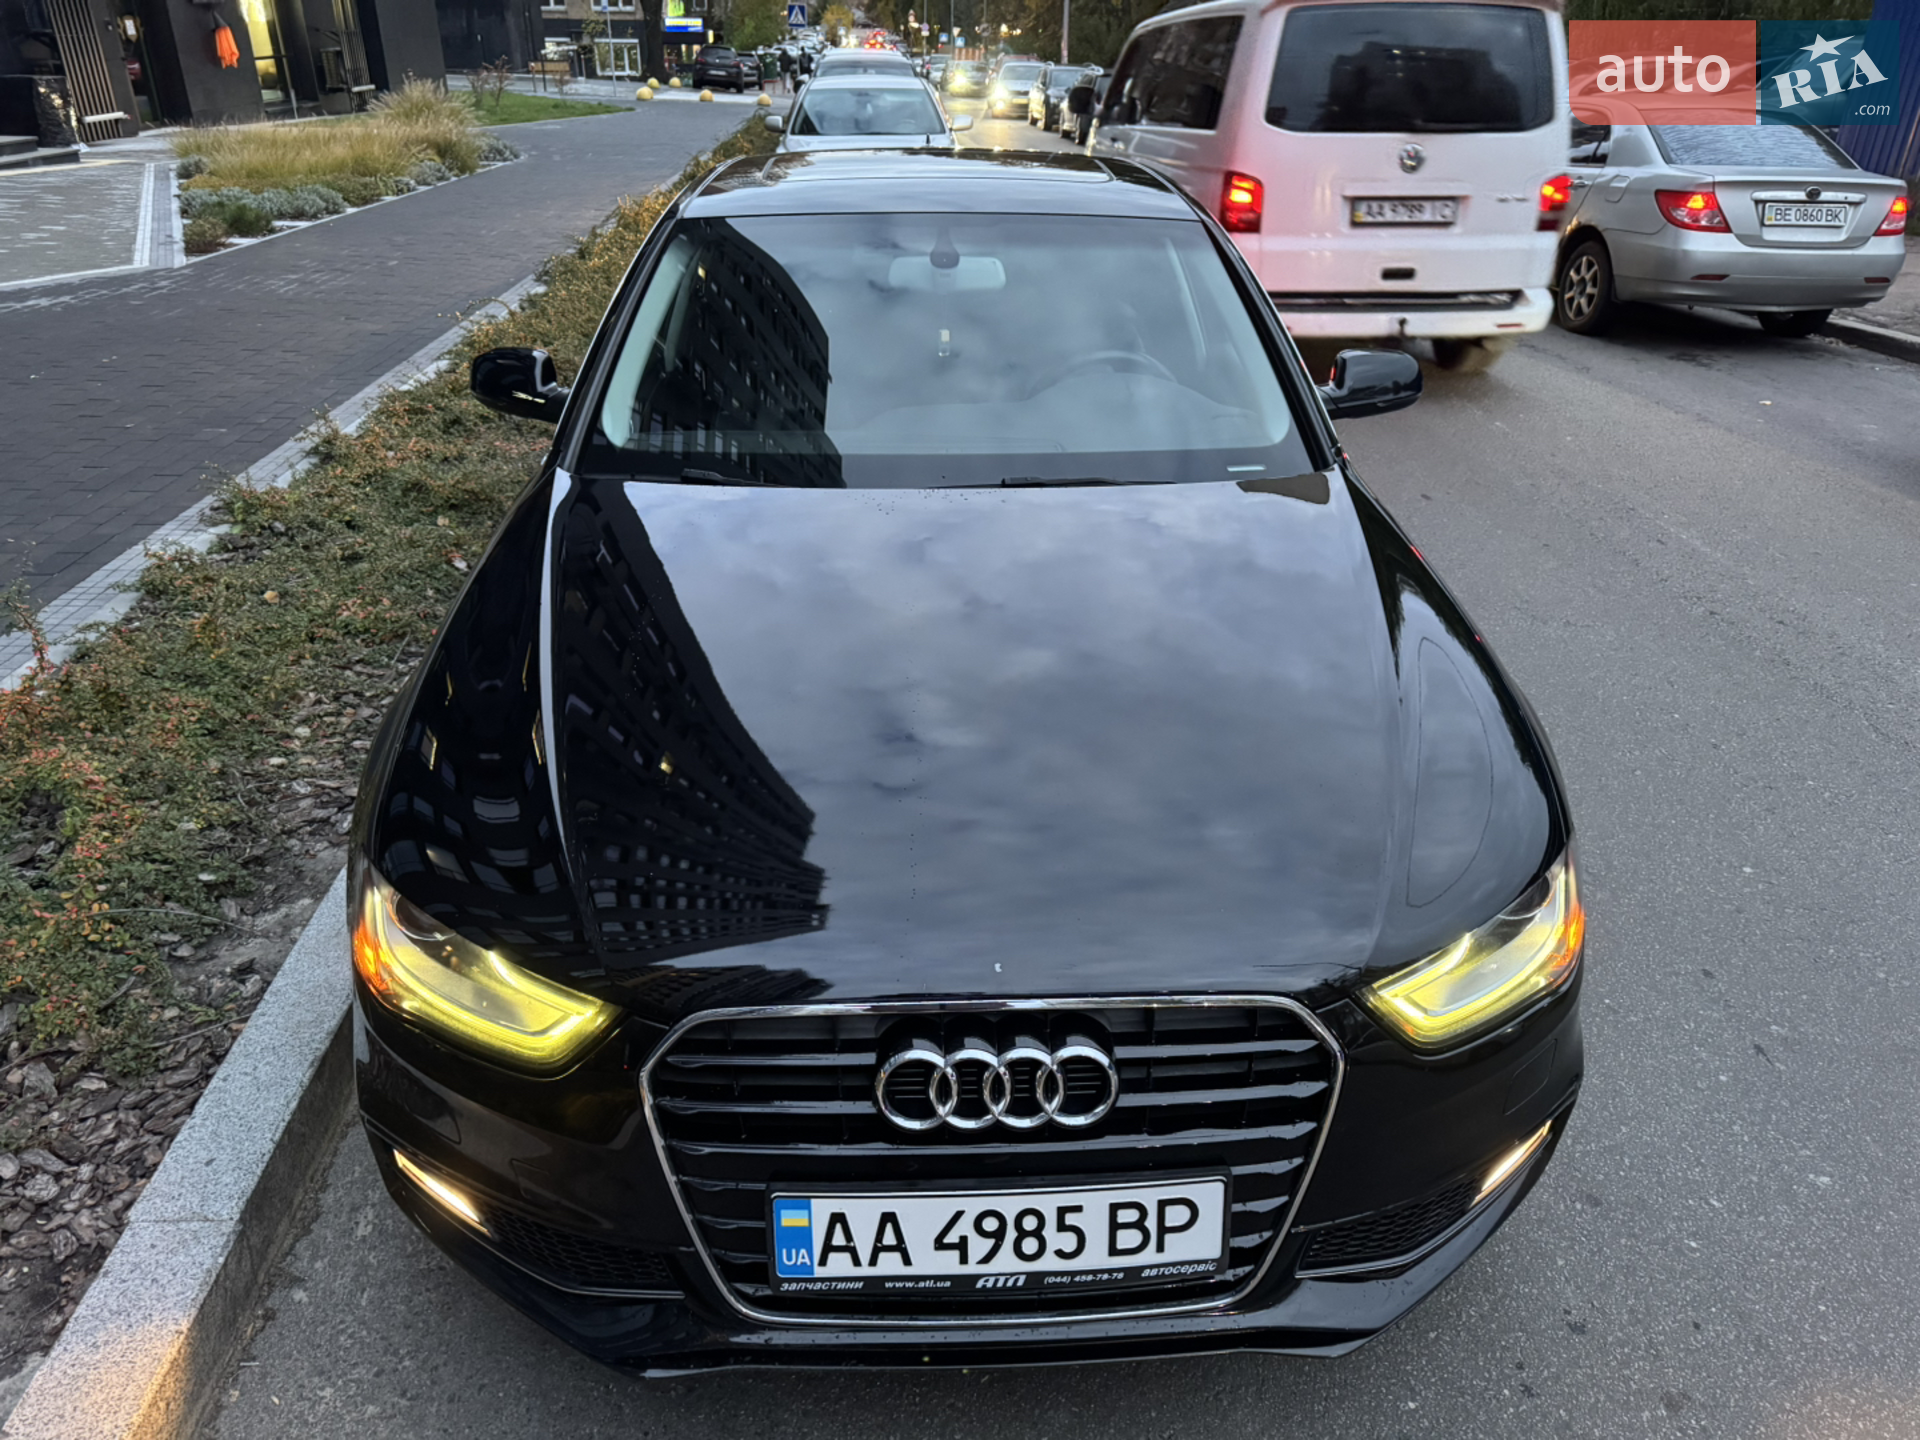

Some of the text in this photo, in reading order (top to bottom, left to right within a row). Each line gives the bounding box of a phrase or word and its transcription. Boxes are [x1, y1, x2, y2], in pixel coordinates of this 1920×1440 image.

[1774, 207, 1843, 223] BE 0860 BK
[817, 1196, 1199, 1267] AA 4985 BP
[782, 1248, 811, 1266] UA
[779, 1281, 864, 1292] запчастини
[884, 1280, 951, 1288] www.atl.ua
[1141, 1260, 1217, 1278] автосервіс
